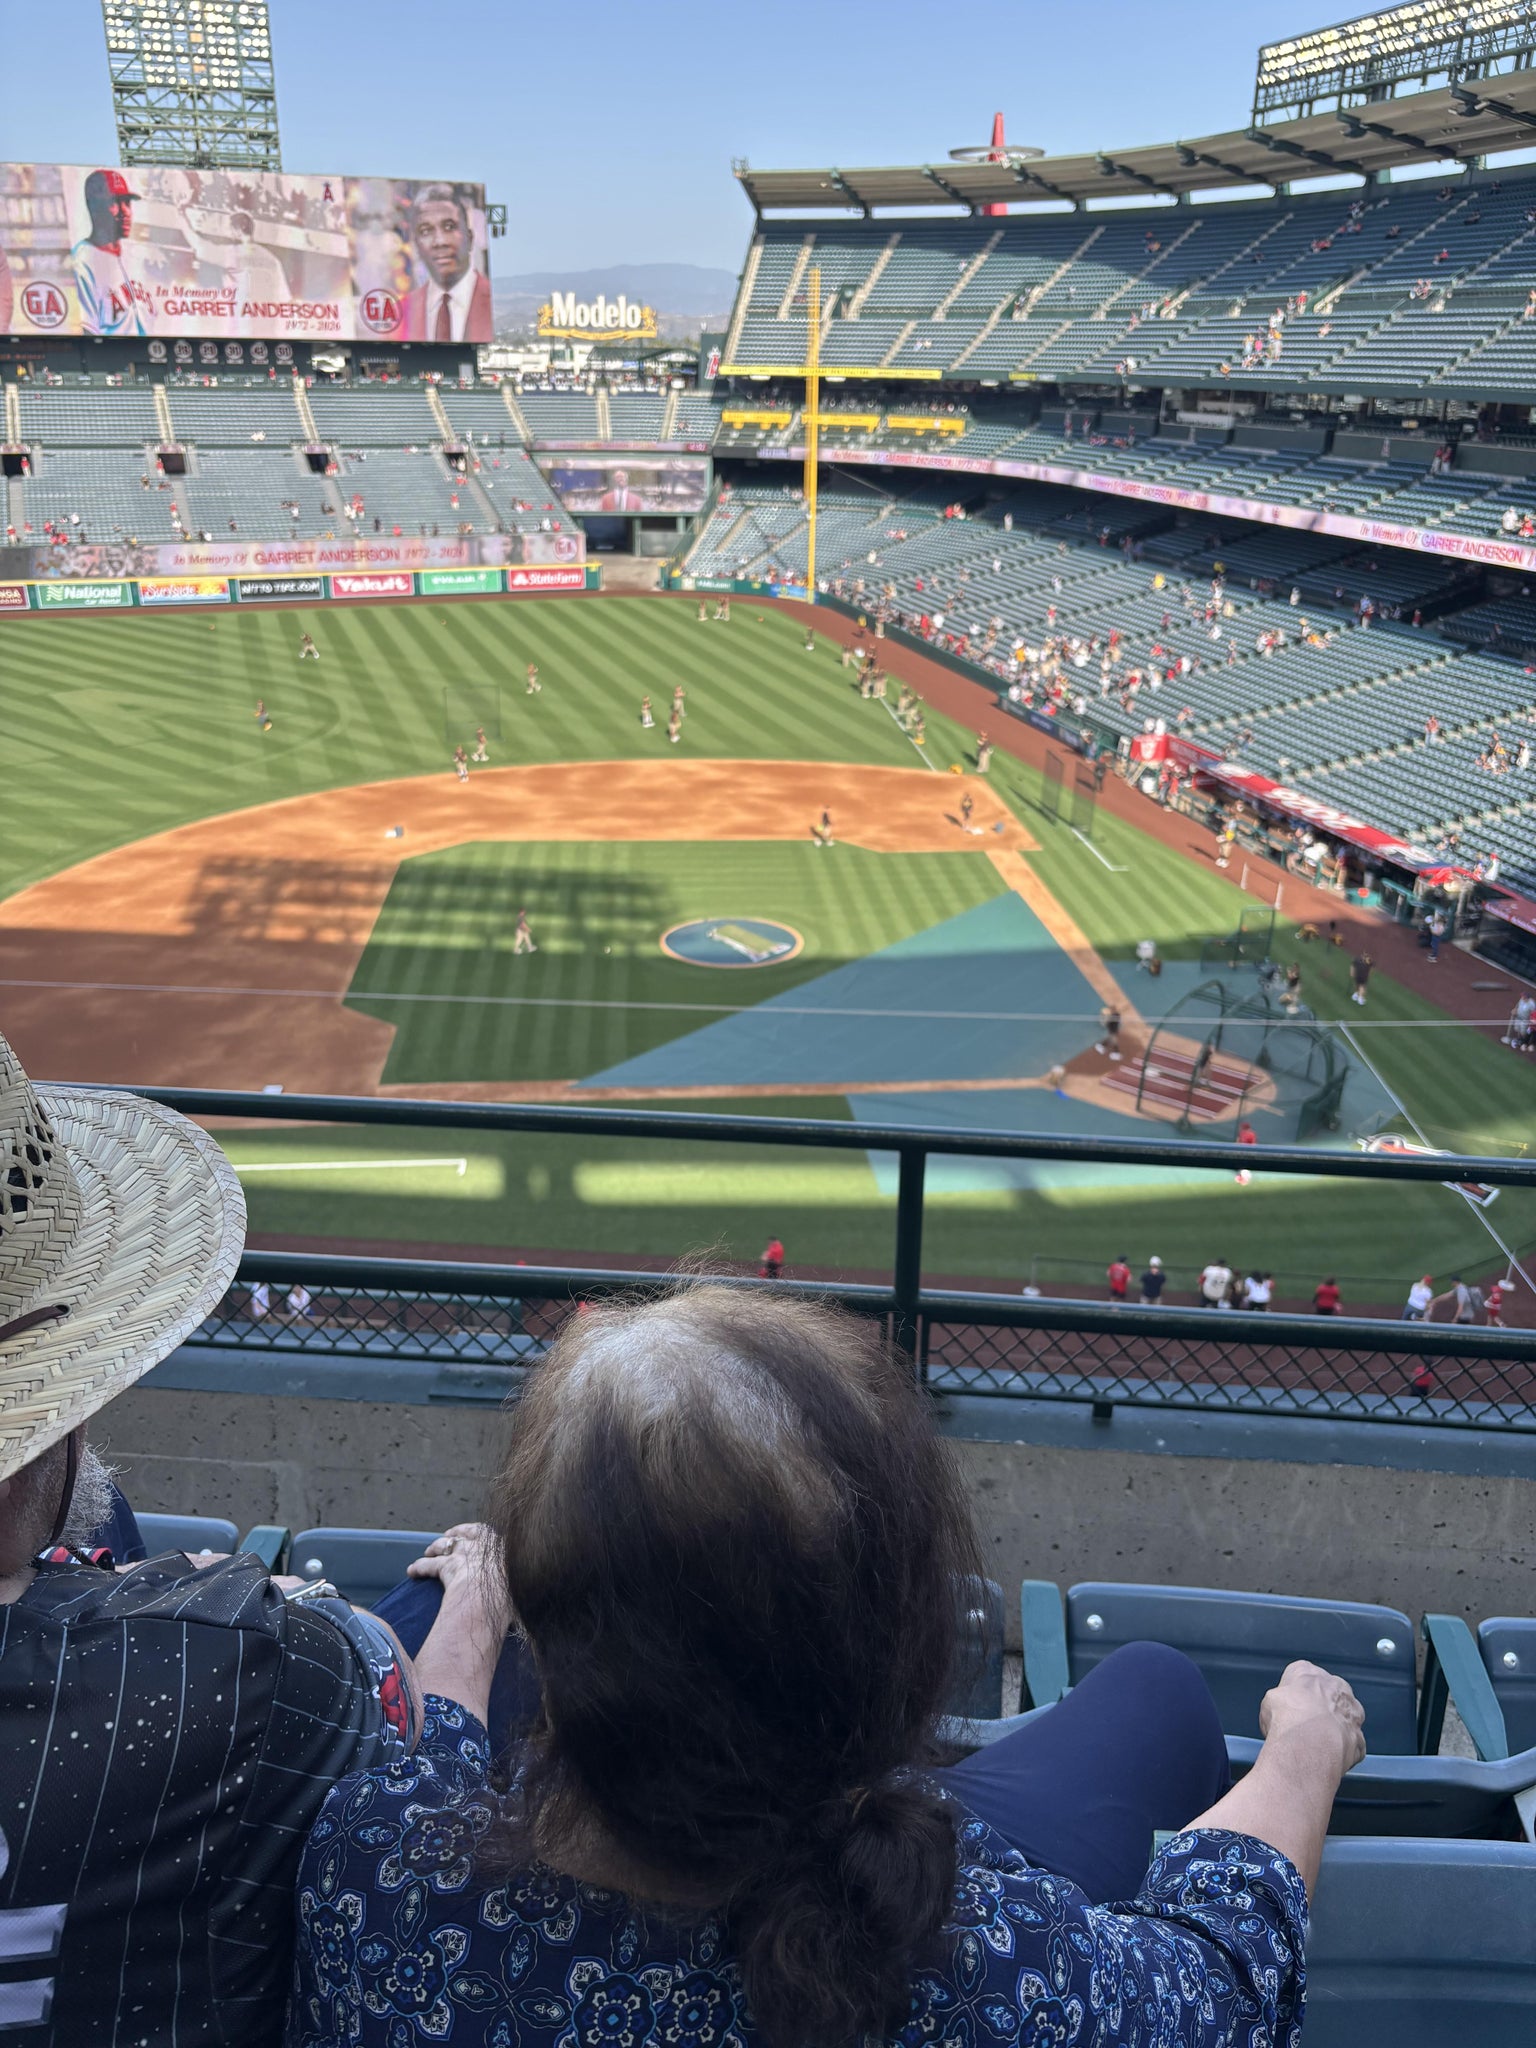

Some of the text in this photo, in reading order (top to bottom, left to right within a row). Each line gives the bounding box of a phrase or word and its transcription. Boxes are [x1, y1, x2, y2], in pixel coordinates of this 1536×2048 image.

[155, 286, 237, 300] In Memory Of
[26, 290, 63, 316] GA
[164, 300, 340, 319] GARRET ANDERSON
[366, 297, 397, 321] GA
[551, 291, 642, 328] Modelo
[254, 550, 315, 566] GARRET
[319, 547, 400, 562] ANDERSON
[1464, 542, 1524, 562] ANDERSON
[64, 585, 122, 599] National
